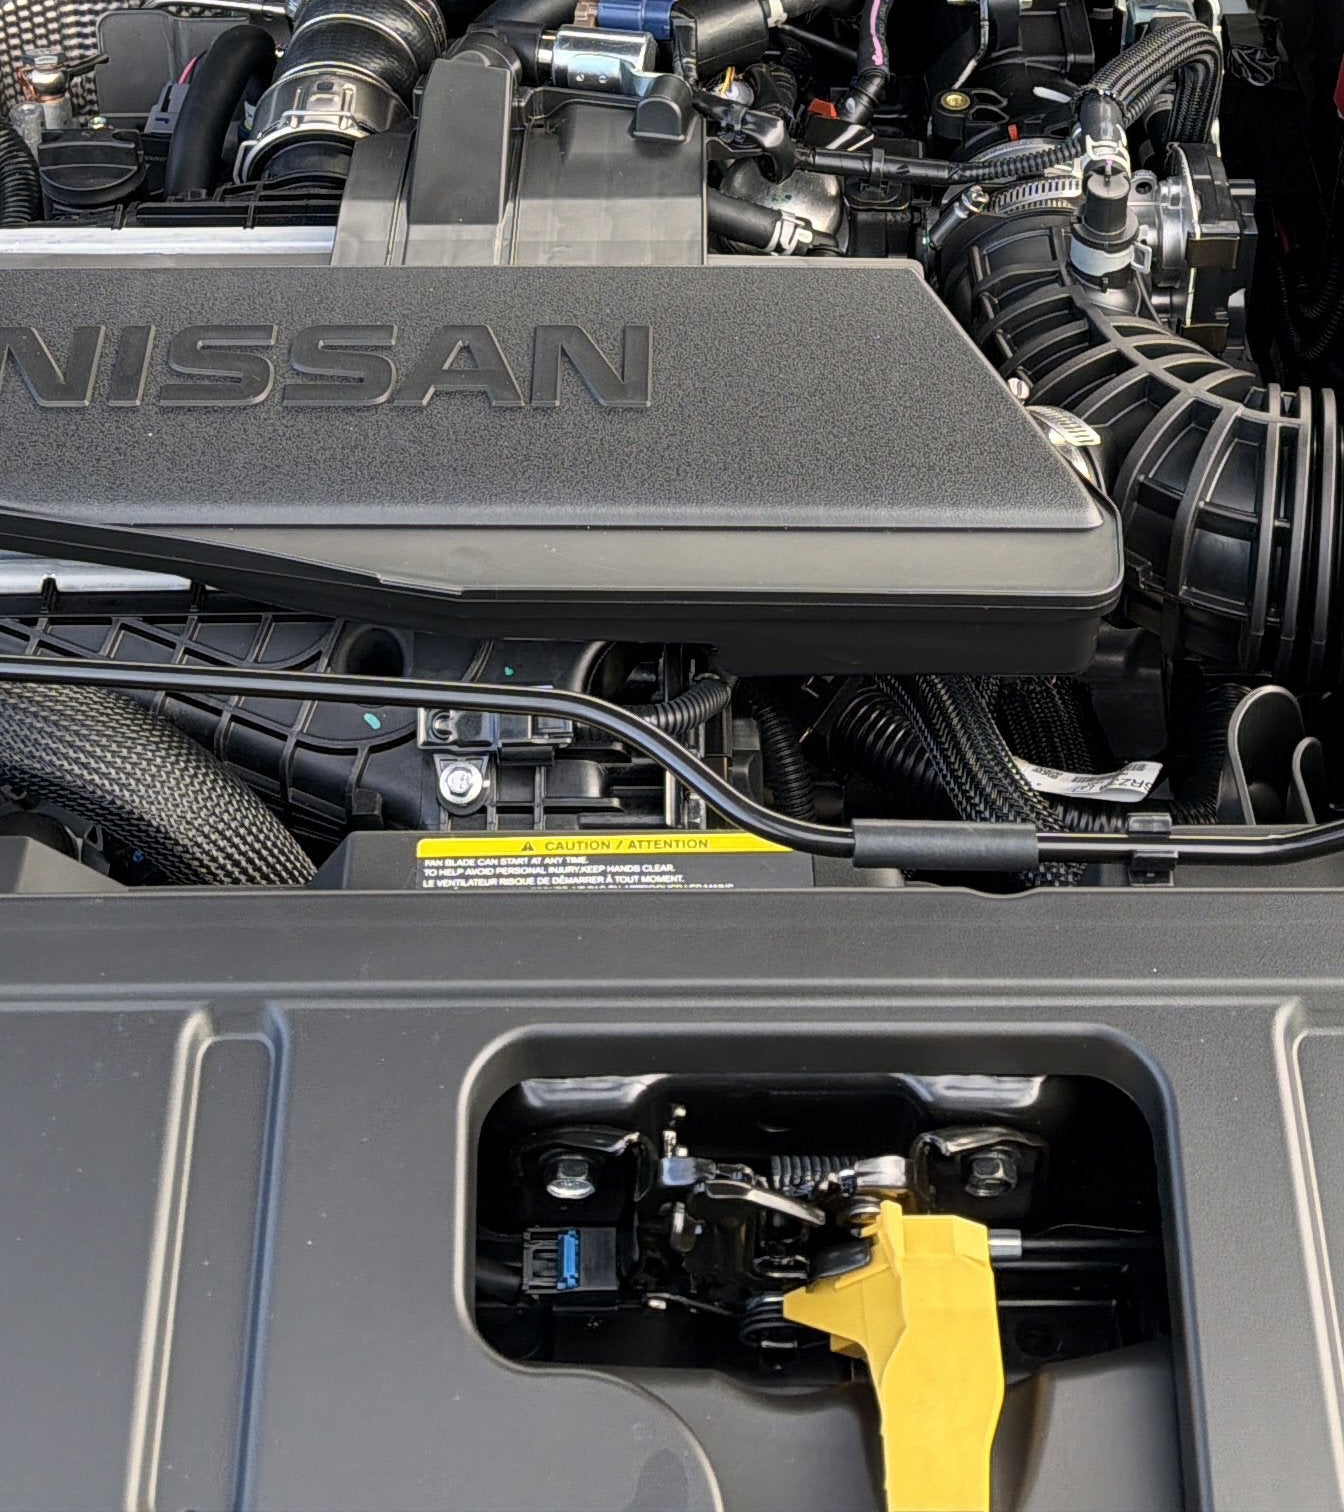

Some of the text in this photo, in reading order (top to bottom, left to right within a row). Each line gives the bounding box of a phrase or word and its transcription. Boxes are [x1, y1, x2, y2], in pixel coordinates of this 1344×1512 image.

[544, 840, 610, 851] CAUTION
[628, 838, 709, 849] ATTENTION
[424, 856, 589, 867] FAN BLADE CAN START AT ANY TIME.
[424, 869, 437, 877] TO
[439, 868, 464, 877] HELP
[465, 867, 494, 876] AVOID
[496, 866, 547, 875] PERSONAL
[606, 864, 640, 873] HANDS
[642, 863, 676, 873] CLEAR.
[422, 879, 435, 888] LE
[436, 877, 498, 888] VENTILATEUR
[498, 876, 535, 886] RISQUE
[536, 876, 550, 886] DE
[551, 874, 604, 886] DÉMARRER
[614, 874, 639, 884] TOUT
[640, 873, 685, 884] MOMENT.
